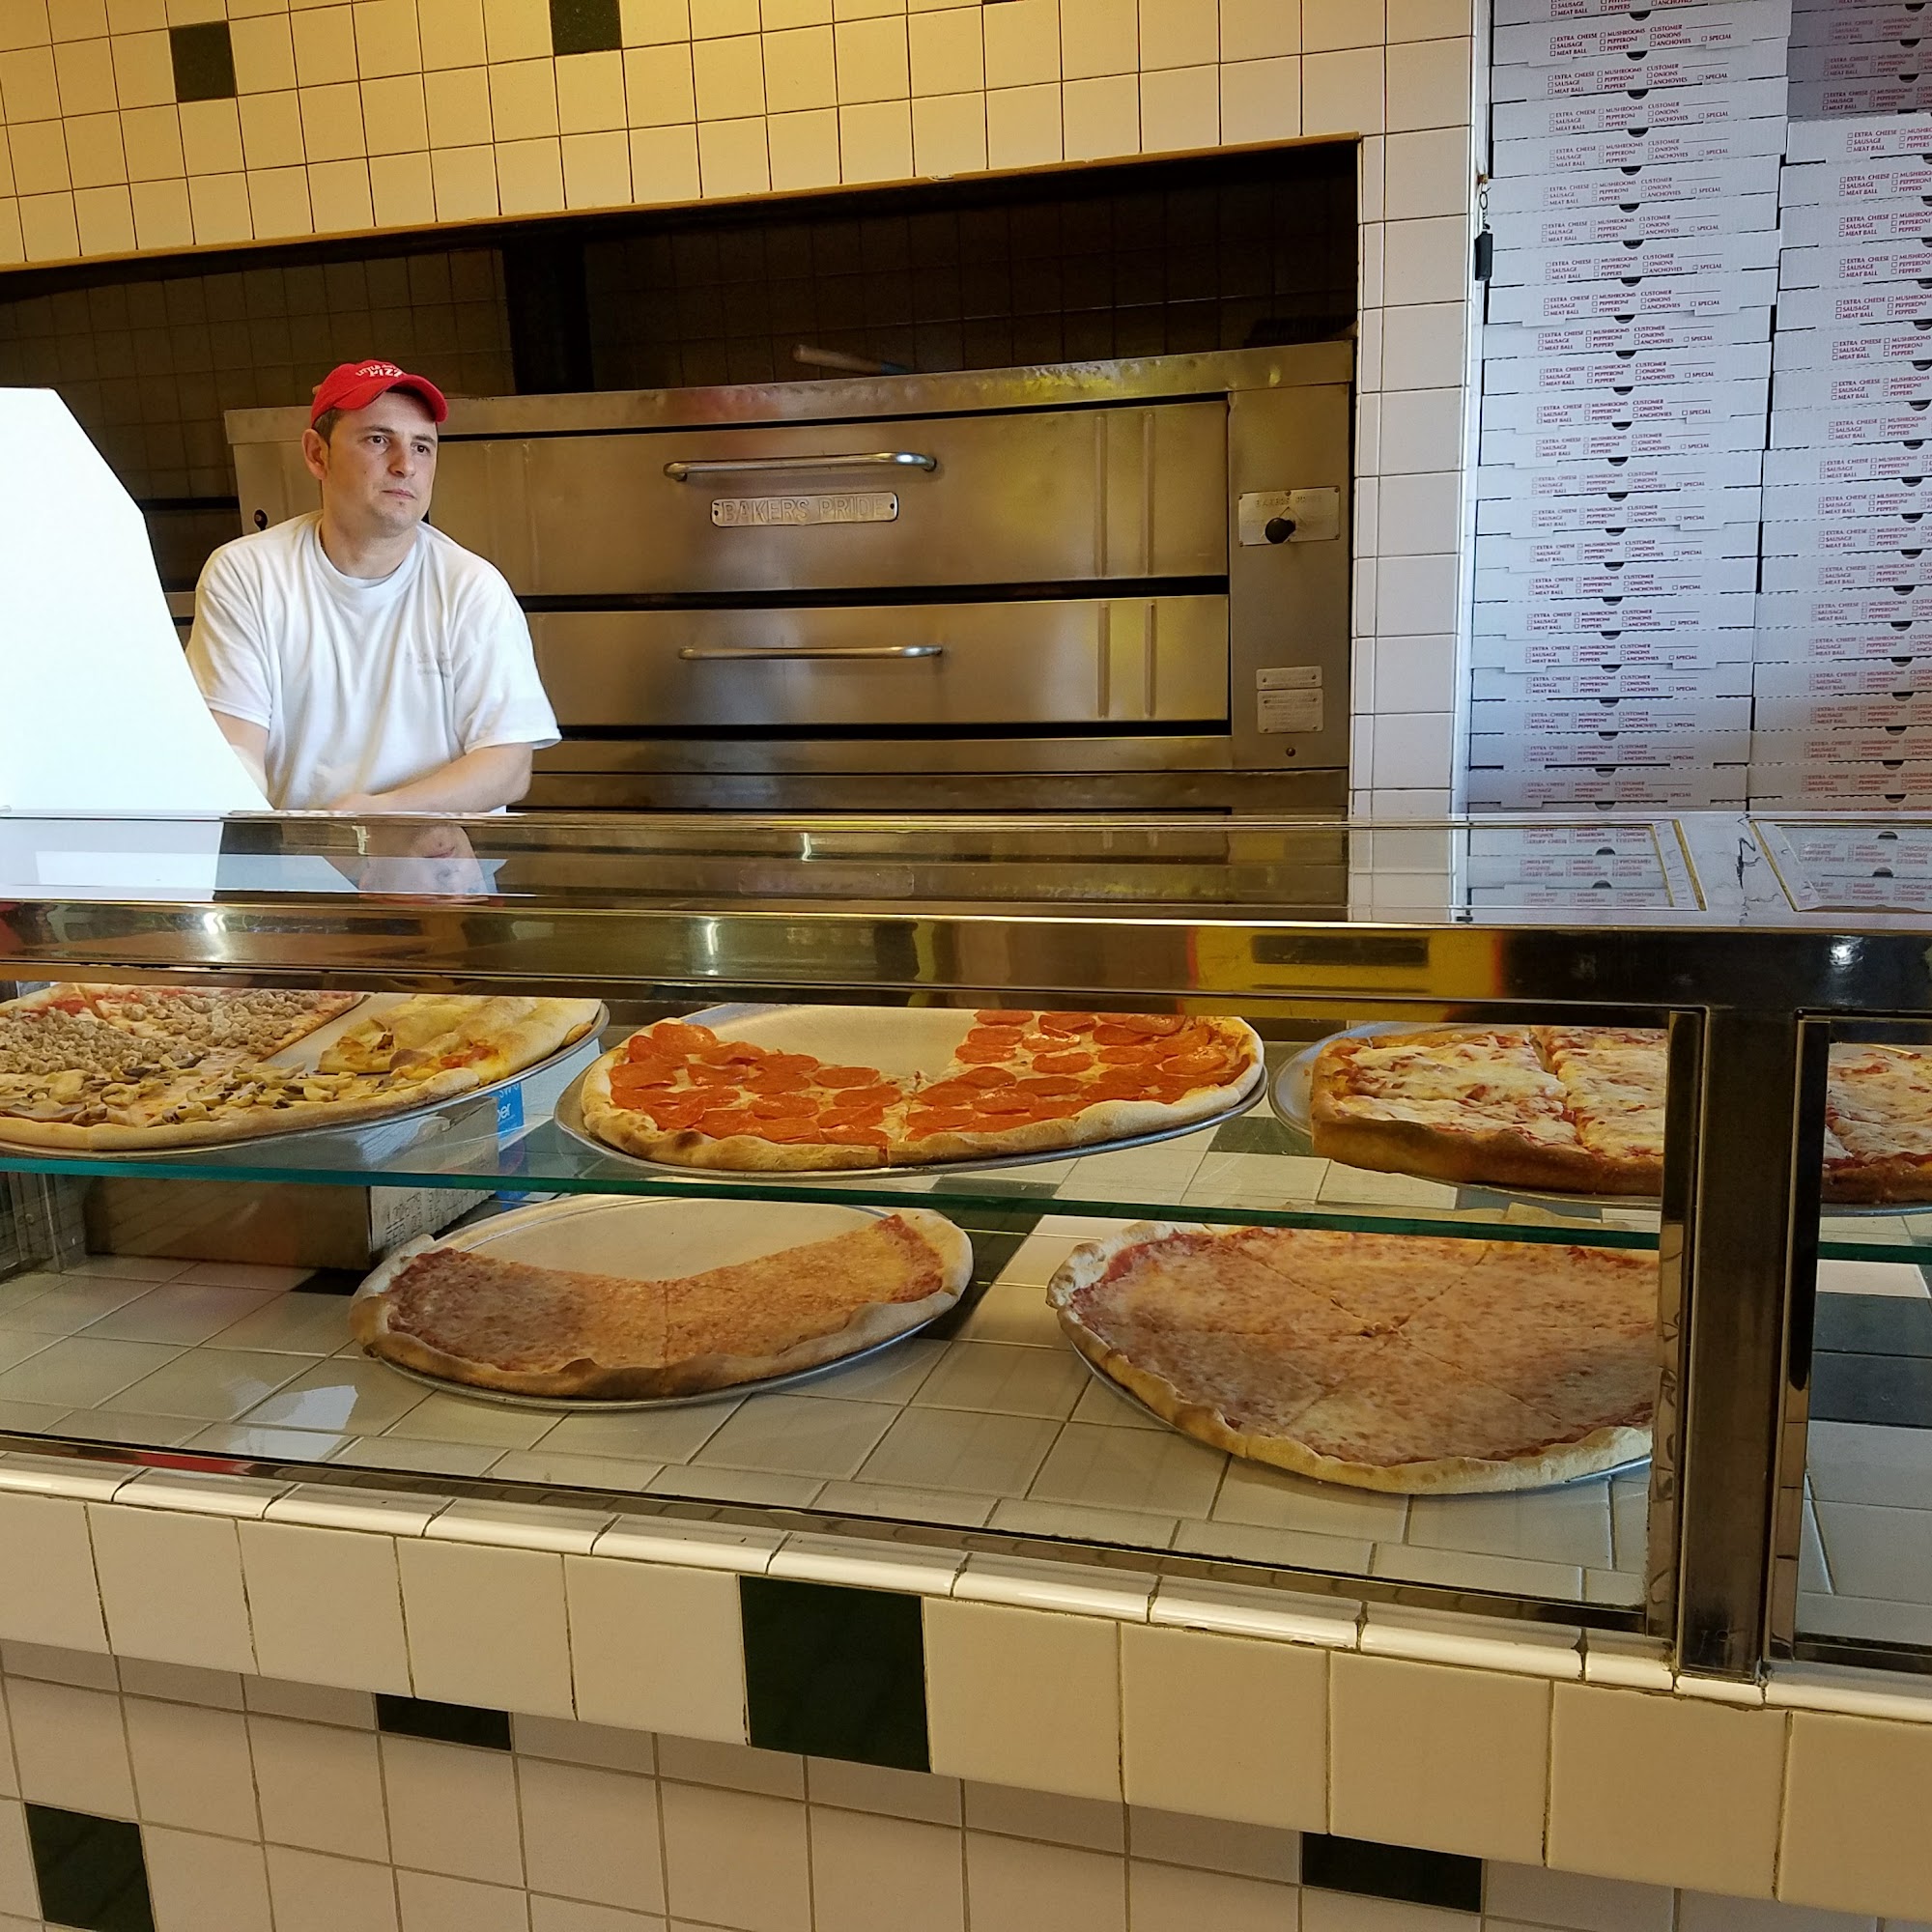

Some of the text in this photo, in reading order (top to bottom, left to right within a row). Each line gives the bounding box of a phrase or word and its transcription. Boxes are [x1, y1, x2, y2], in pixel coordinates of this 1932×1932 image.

[1606, 28, 1646, 37] MUSHROOMS
[1649, 24, 1683, 33] CUSTOMER
[1606, 36, 1638, 44] PEPPERONI
[1656, 38, 1691, 46] ANCHOVIES
[1556, 41, 1582, 49] SAUSAGE
[1604, 67, 1642, 75] MUSHROOMS
[1646, 63, 1679, 71] CUSTOMER
[1653, 76, 1688, 85] ANCHOVIES
[1605, 104, 1644, 113] MUSHROOMS
[1891, 334, 1932, 343] MUSHROOMS
[722, 496, 886, 523] BAKERS PRIDE
